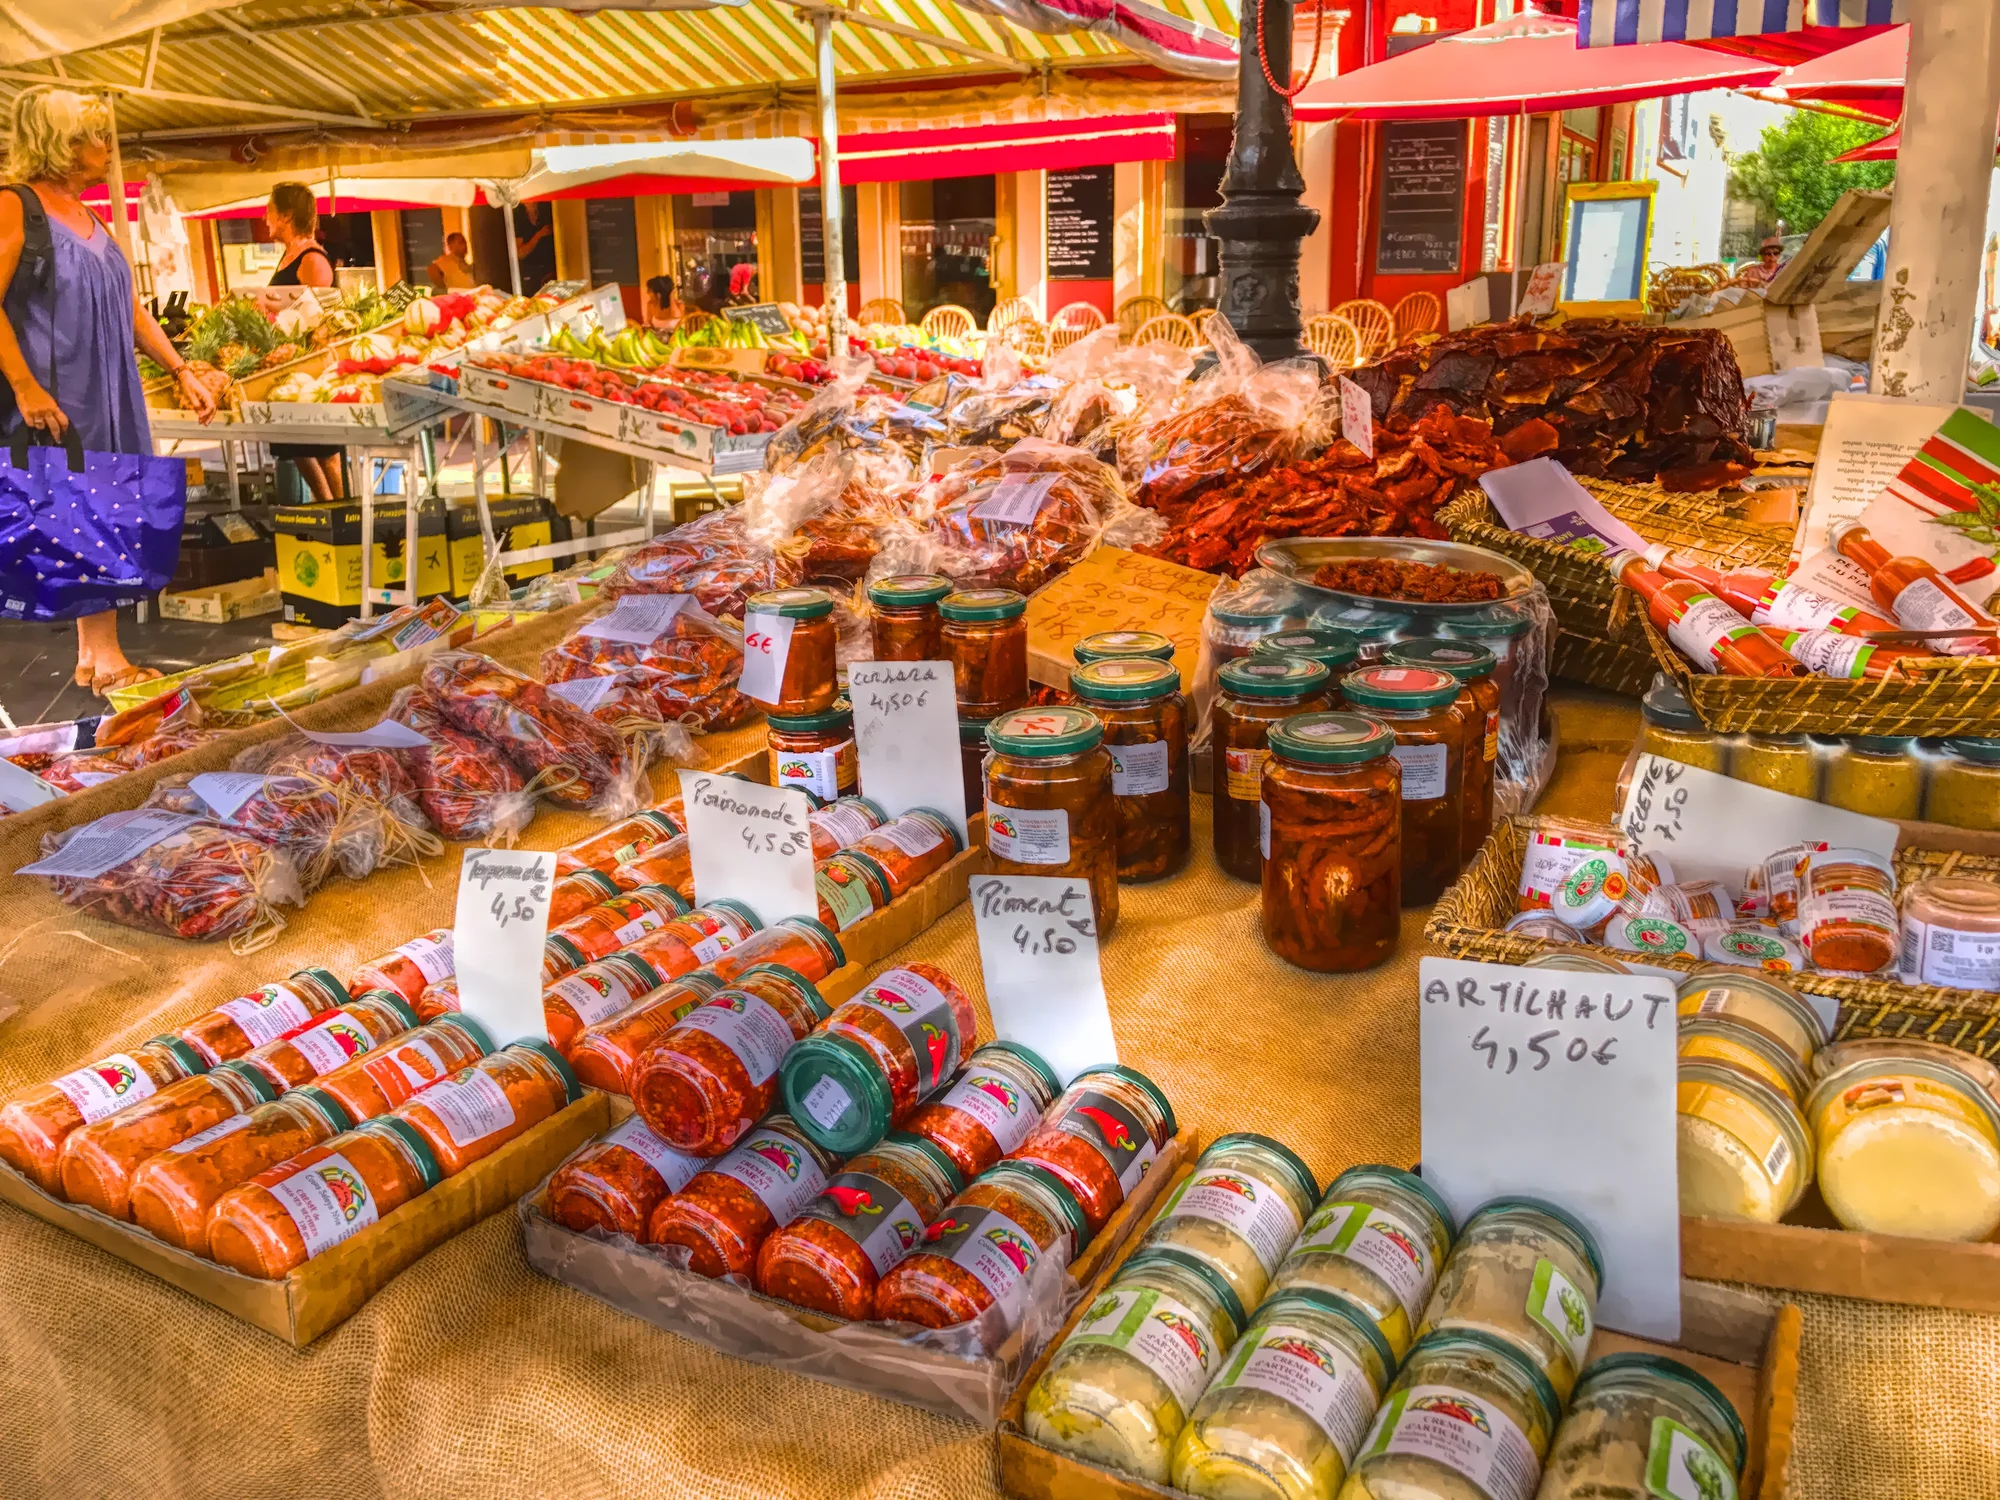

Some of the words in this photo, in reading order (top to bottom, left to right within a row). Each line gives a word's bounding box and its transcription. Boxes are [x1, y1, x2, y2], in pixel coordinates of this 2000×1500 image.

[1826, 564, 1845, 576] DU
[745, 632, 773, 655] 6€
[869, 690, 929, 716] 4,50€
[962, 1099, 998, 1126] PIMENT
[626, 1134, 664, 1159] PIMENT
[734, 1164, 771, 1191] PIMENT
[740, 1159, 767, 1178] CREME
[1187, 1193, 1247, 1216] d'ARTICHAUT
[1202, 1188, 1235, 1202] CREME
[977, 1237, 999, 1255] Cours
[1380, 1239, 1409, 1268] CREME
[980, 1253, 1008, 1281] CREME
[1163, 1333, 1192, 1364] CREME
[1272, 1354, 1311, 1374] CREME
[1255, 1359, 1324, 1394] d'ARTICHAUT
[1423, 1415, 1465, 1434] CREME
